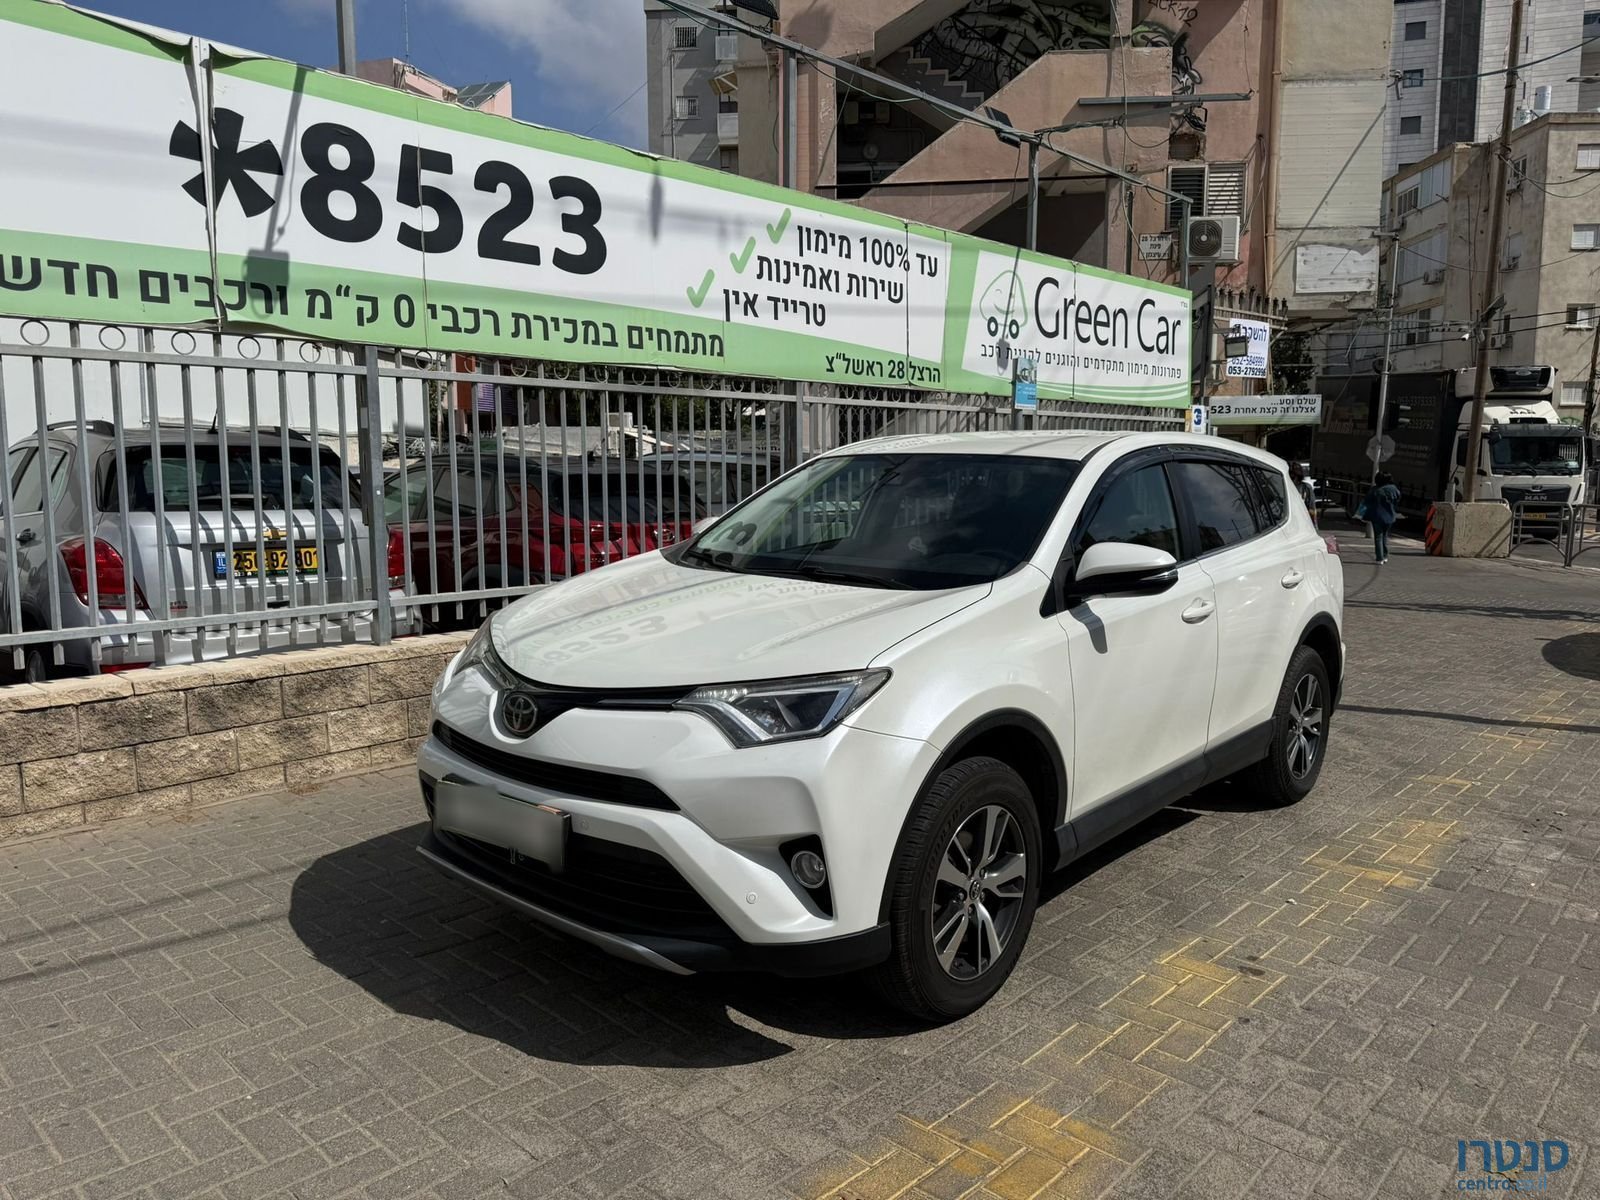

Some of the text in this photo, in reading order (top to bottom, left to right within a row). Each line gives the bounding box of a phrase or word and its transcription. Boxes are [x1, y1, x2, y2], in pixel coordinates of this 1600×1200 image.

[797, 225, 938, 278] עד 100% מימון
[757, 255, 904, 304] שירות ואמינות
[139, 268, 289, 316] ורכבים
[723, 288, 826, 327] טרייד אין
[1034, 276, 1181, 356] Green Car
[426, 302, 501, 337] רכבי
[510, 311, 619, 348] במכירת
[627, 324, 724, 358] מתמחים
[888, 358, 906, 380] 28
[909, 361, 941, 384] הרצל
[1084, 357, 1124, 375] מתקדמים
[1127, 361, 1149, 377] מימון
[1151, 365, 1182, 379] פתרונות
[1233, 406, 1258, 415] אחרת
[1259, 406, 1278, 416] קצת
[1280, 406, 1290, 414] זה
[1292, 405, 1316, 414] אצלנו
[1297, 396, 1317, 405] שלם
